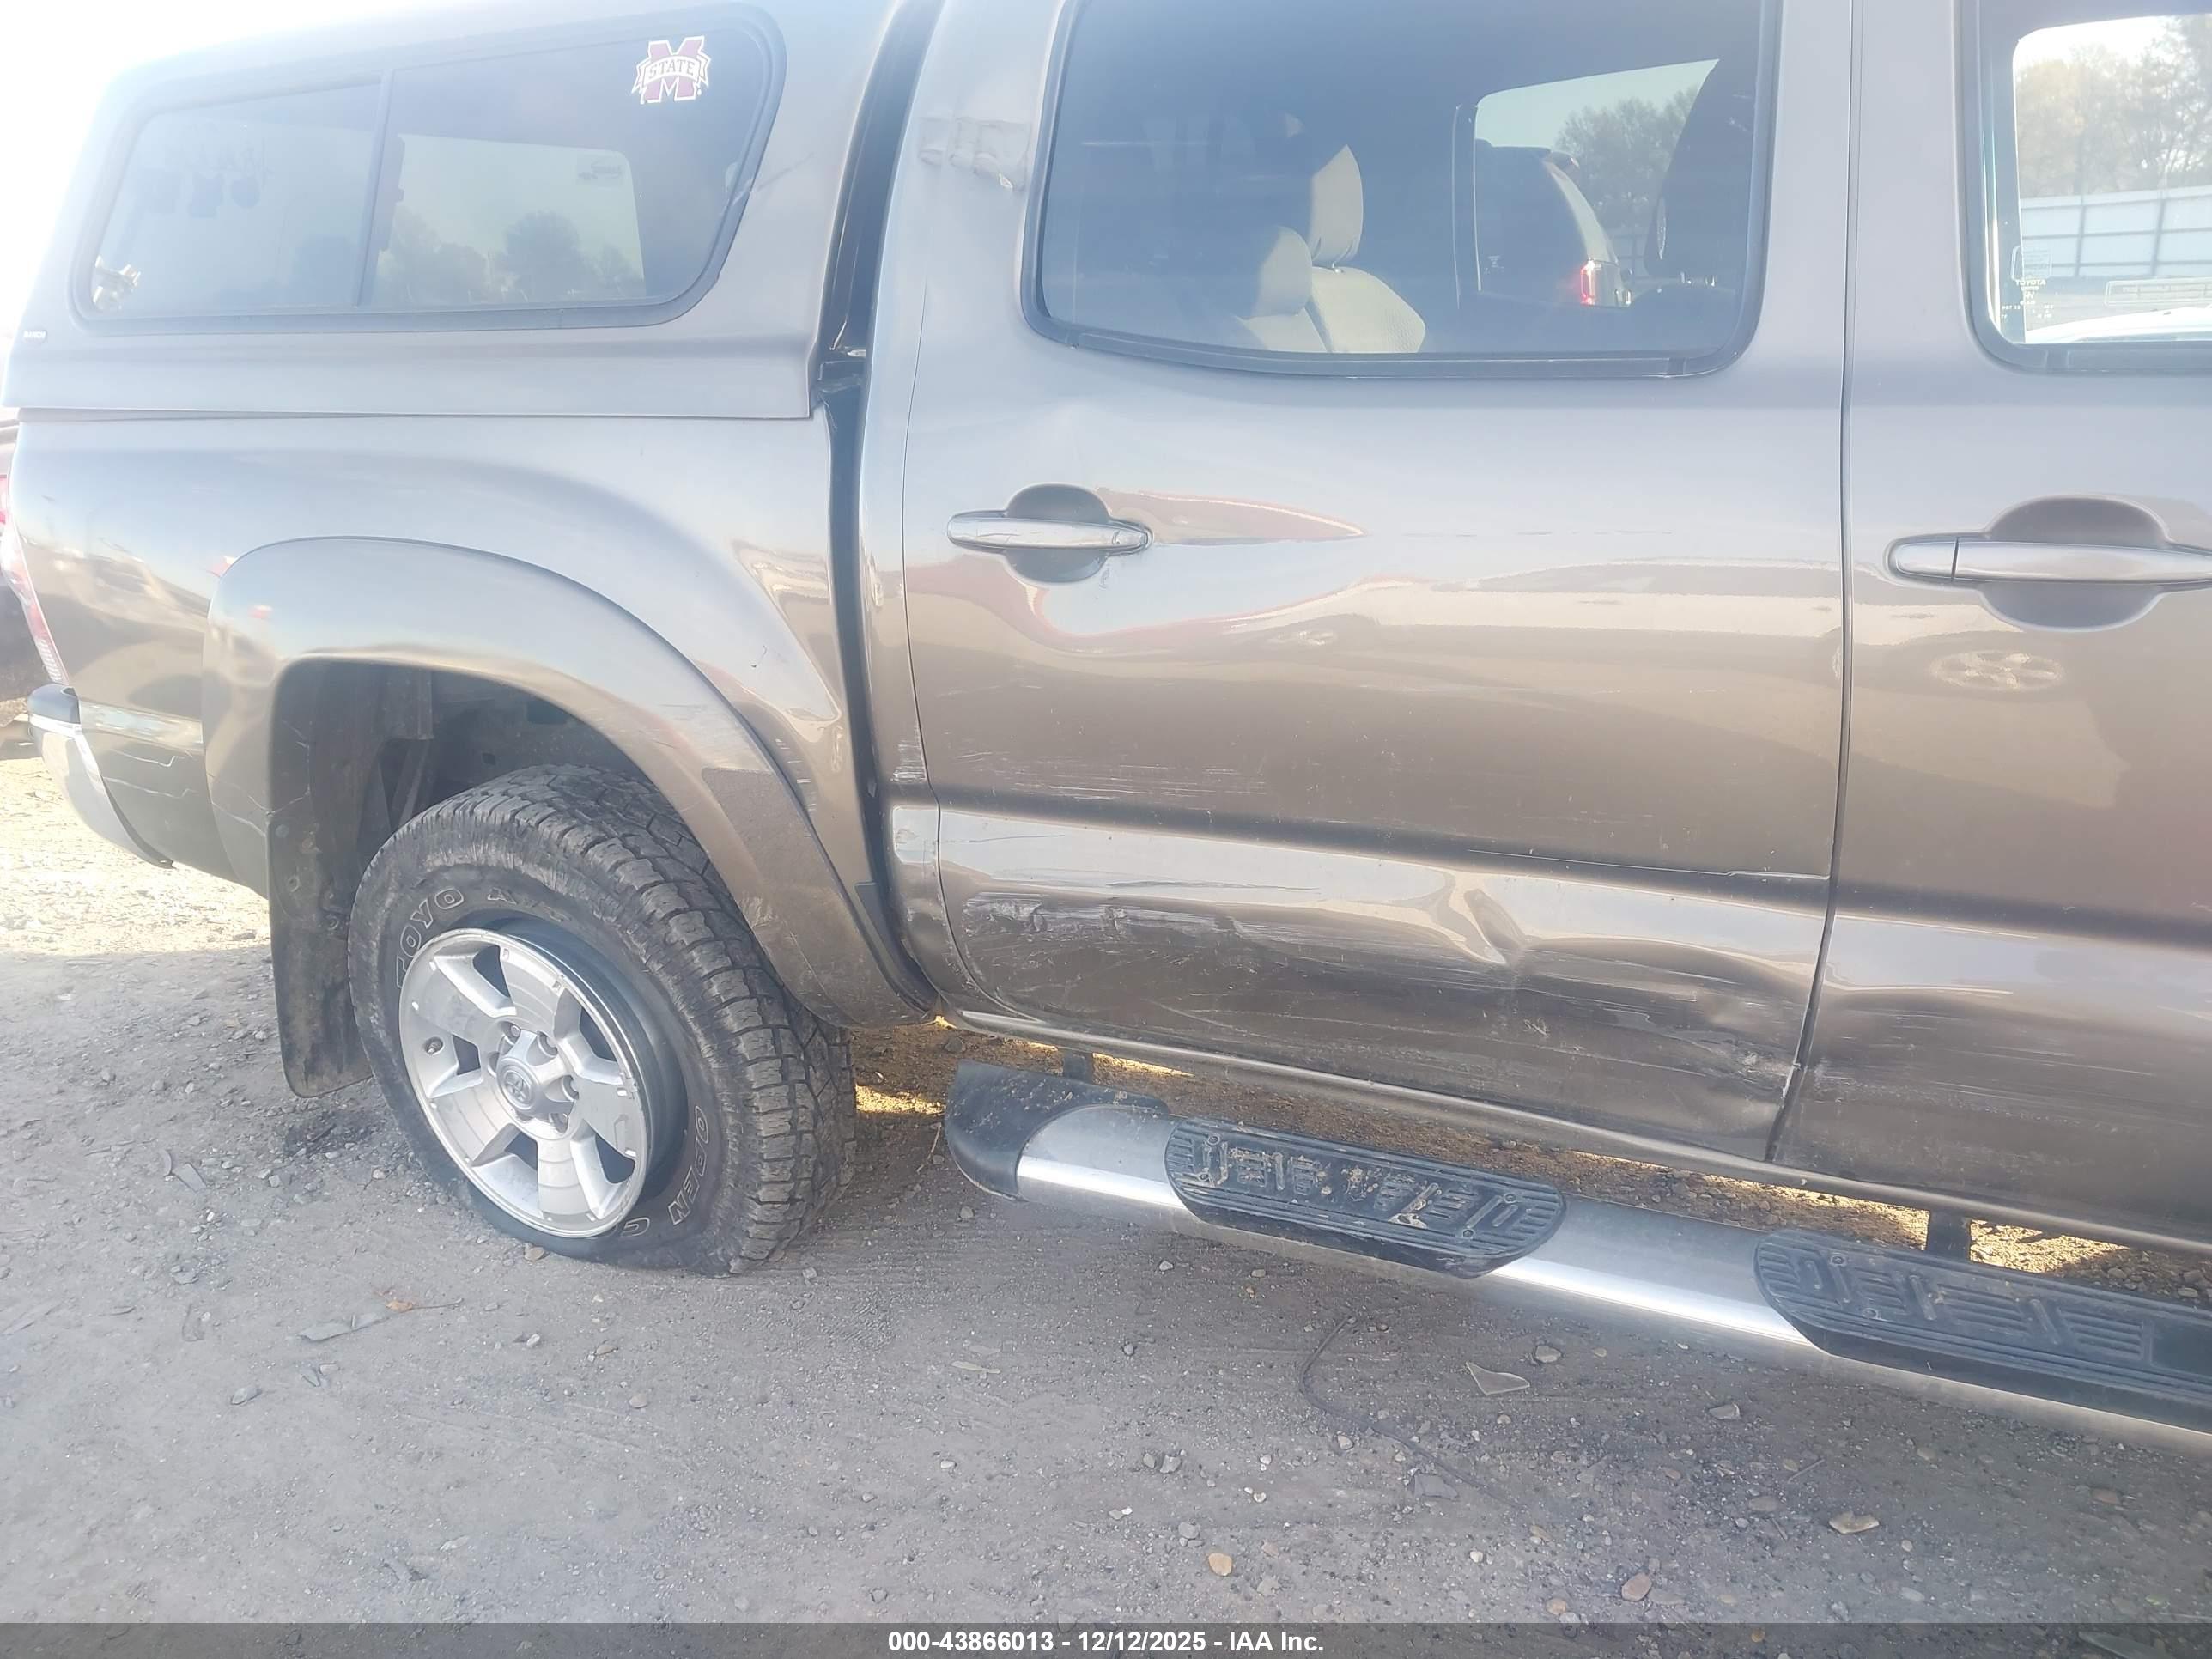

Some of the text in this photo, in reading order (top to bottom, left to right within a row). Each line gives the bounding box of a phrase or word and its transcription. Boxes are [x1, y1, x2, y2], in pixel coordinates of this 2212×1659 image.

[648, 58, 696, 80] STATE
[396, 887, 465, 988] TOYO
[667, 1105, 709, 1225] OPEN
